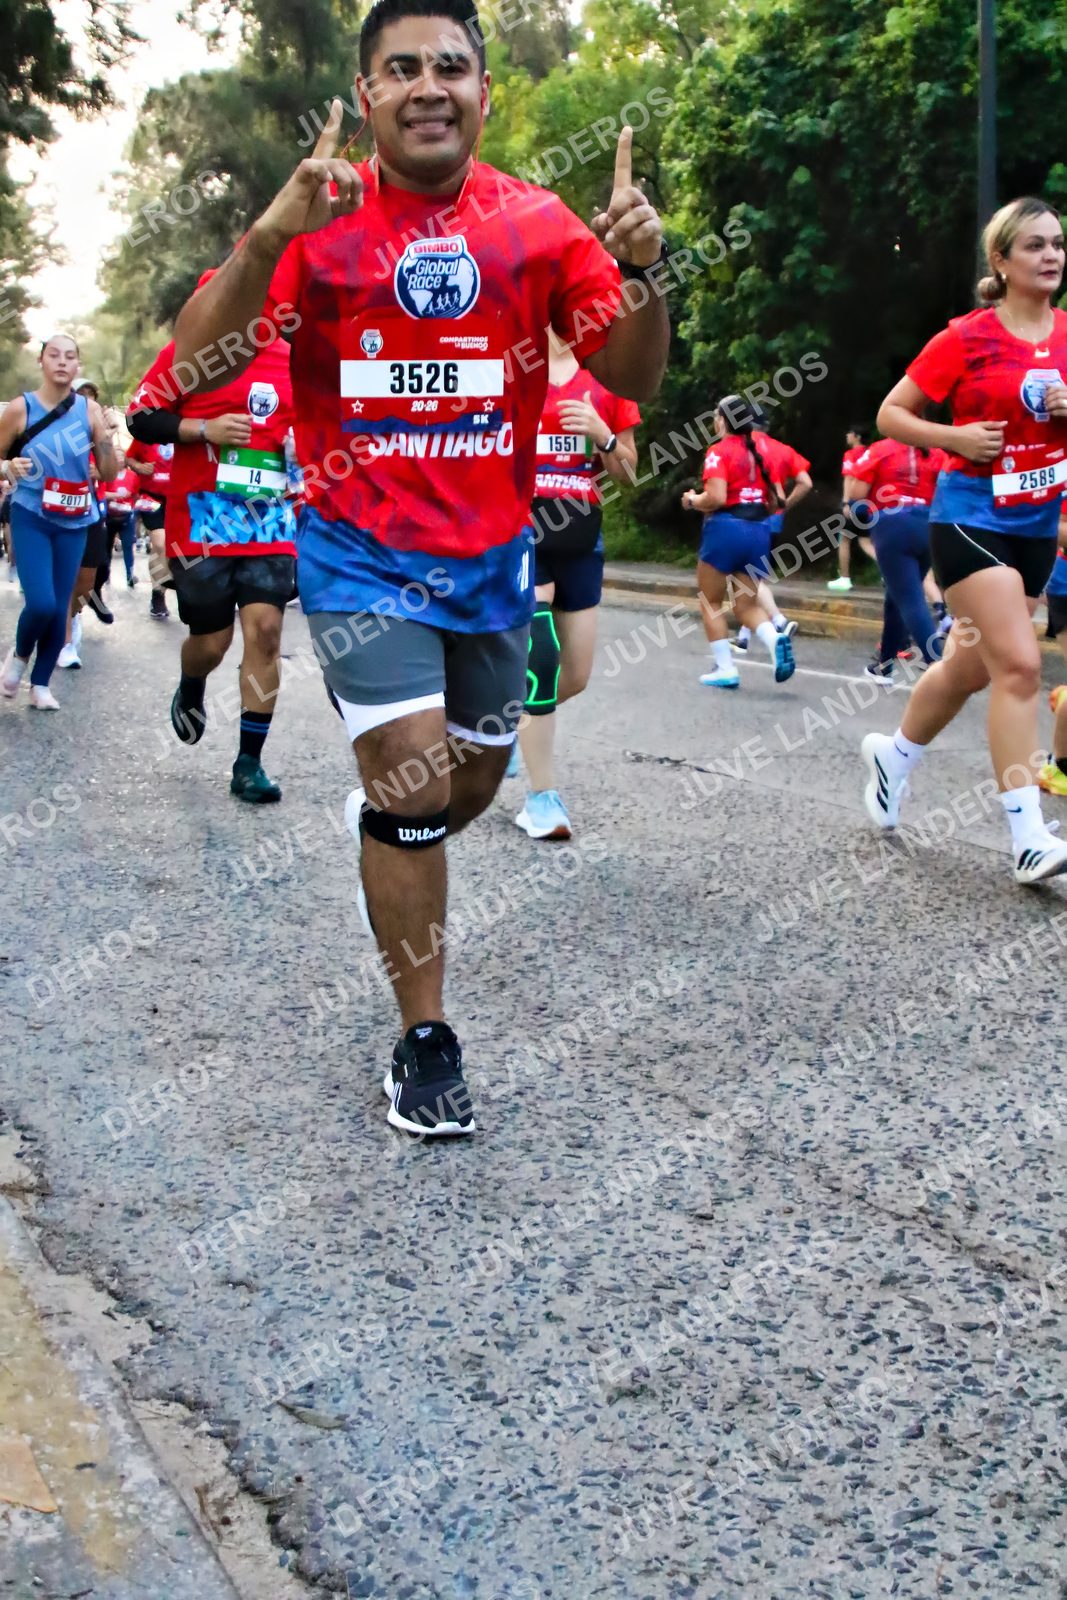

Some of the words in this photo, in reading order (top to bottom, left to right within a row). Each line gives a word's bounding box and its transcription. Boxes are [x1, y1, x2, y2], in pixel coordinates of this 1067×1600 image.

[413, 242, 459, 253] BIMBO
[415, 258, 459, 276] Global
[407, 273, 442, 290] Race
[389, 362, 459, 394] 3526
[368, 421, 514, 459] SANTIAGO
[548, 435, 578, 453] 1551
[249, 469, 262, 485] 14
[1019, 466, 1055, 491] 2589
[60, 494, 83, 507] 2017
[398, 825, 447, 842] Wilson
